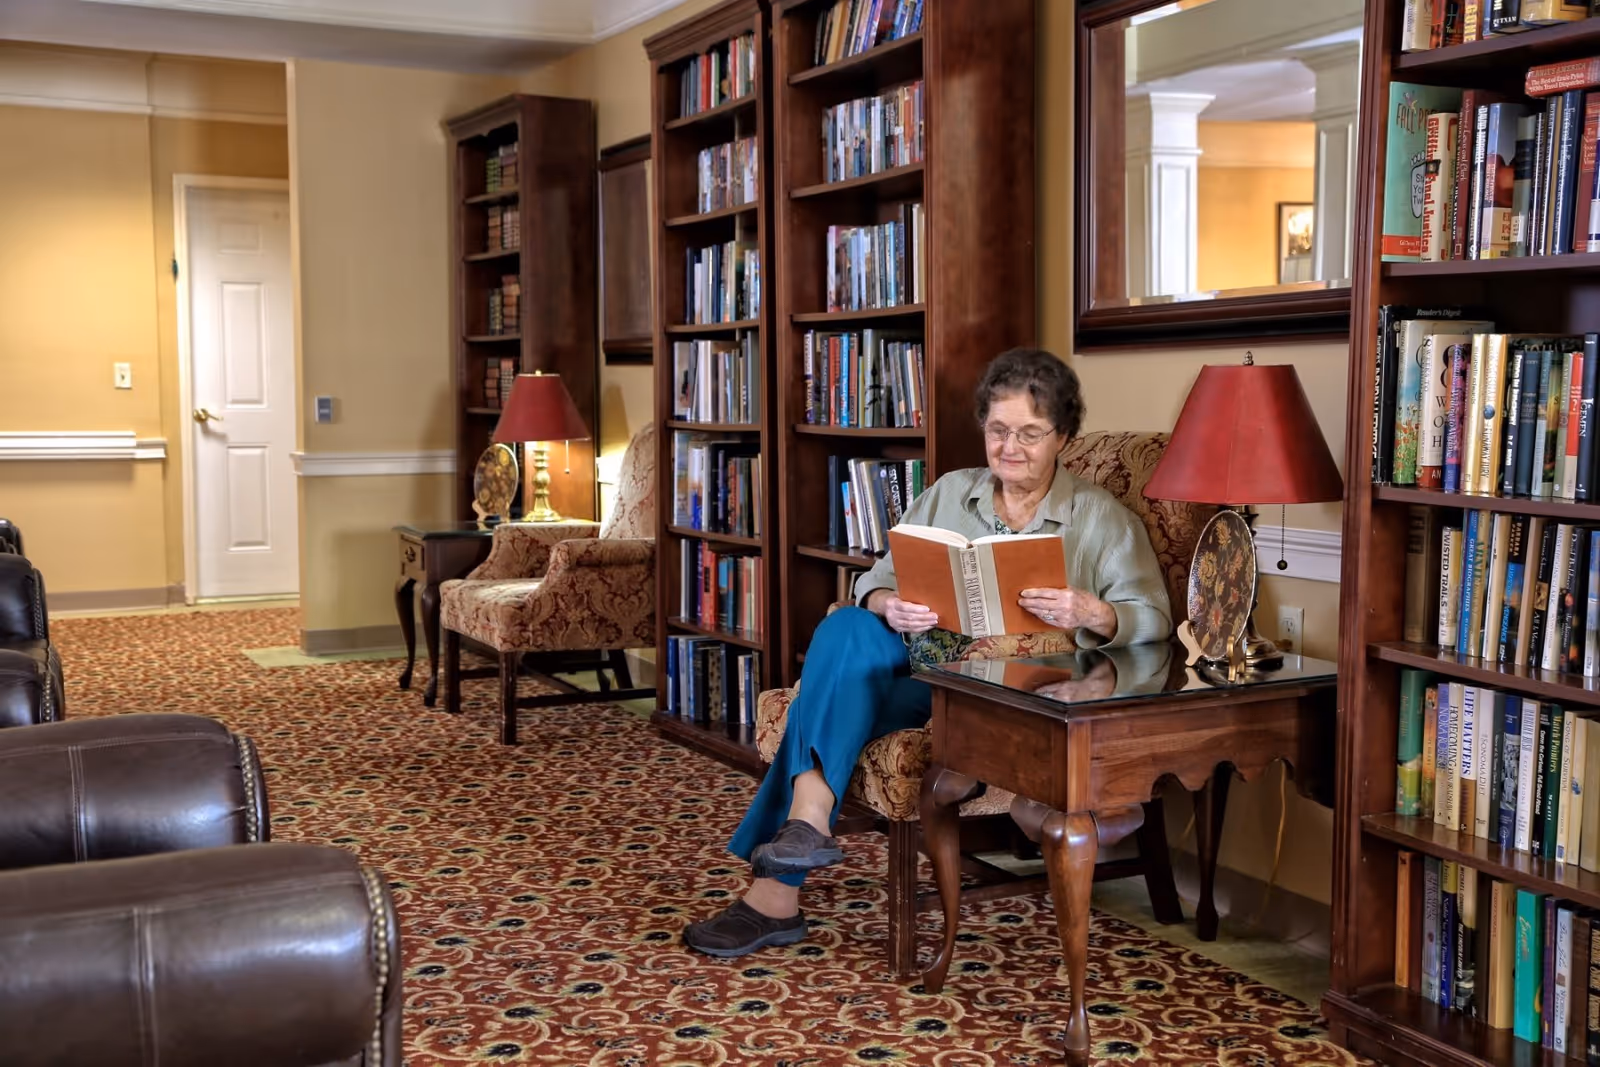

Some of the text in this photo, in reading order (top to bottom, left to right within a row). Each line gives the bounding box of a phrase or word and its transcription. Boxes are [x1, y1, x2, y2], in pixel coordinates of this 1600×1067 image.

[1396, 103, 1415, 135] FALL
[1477, 107, 1488, 130] DAVID
[1422, 173, 1439, 253] Final Justice
[1513, 522, 1522, 557] BARBARA
[1440, 528, 1451, 607] TWISTED TRAILS
[1464, 563, 1473, 612] BIOGRAPHIES
[966, 576, 986, 633] HOME FRONT
[1439, 706, 1448, 735] NORA
[1464, 690, 1475, 717] LIFE
[1448, 705, 1458, 767] HOMECOMING
[1462, 720, 1473, 775] MATTERS
[1549, 715, 1562, 773] Match Pointers
[1564, 720, 1573, 743] SONG
[1479, 738, 1488, 796] SONOMA DIET
[1562, 757, 1572, 793] SURVIVAL
